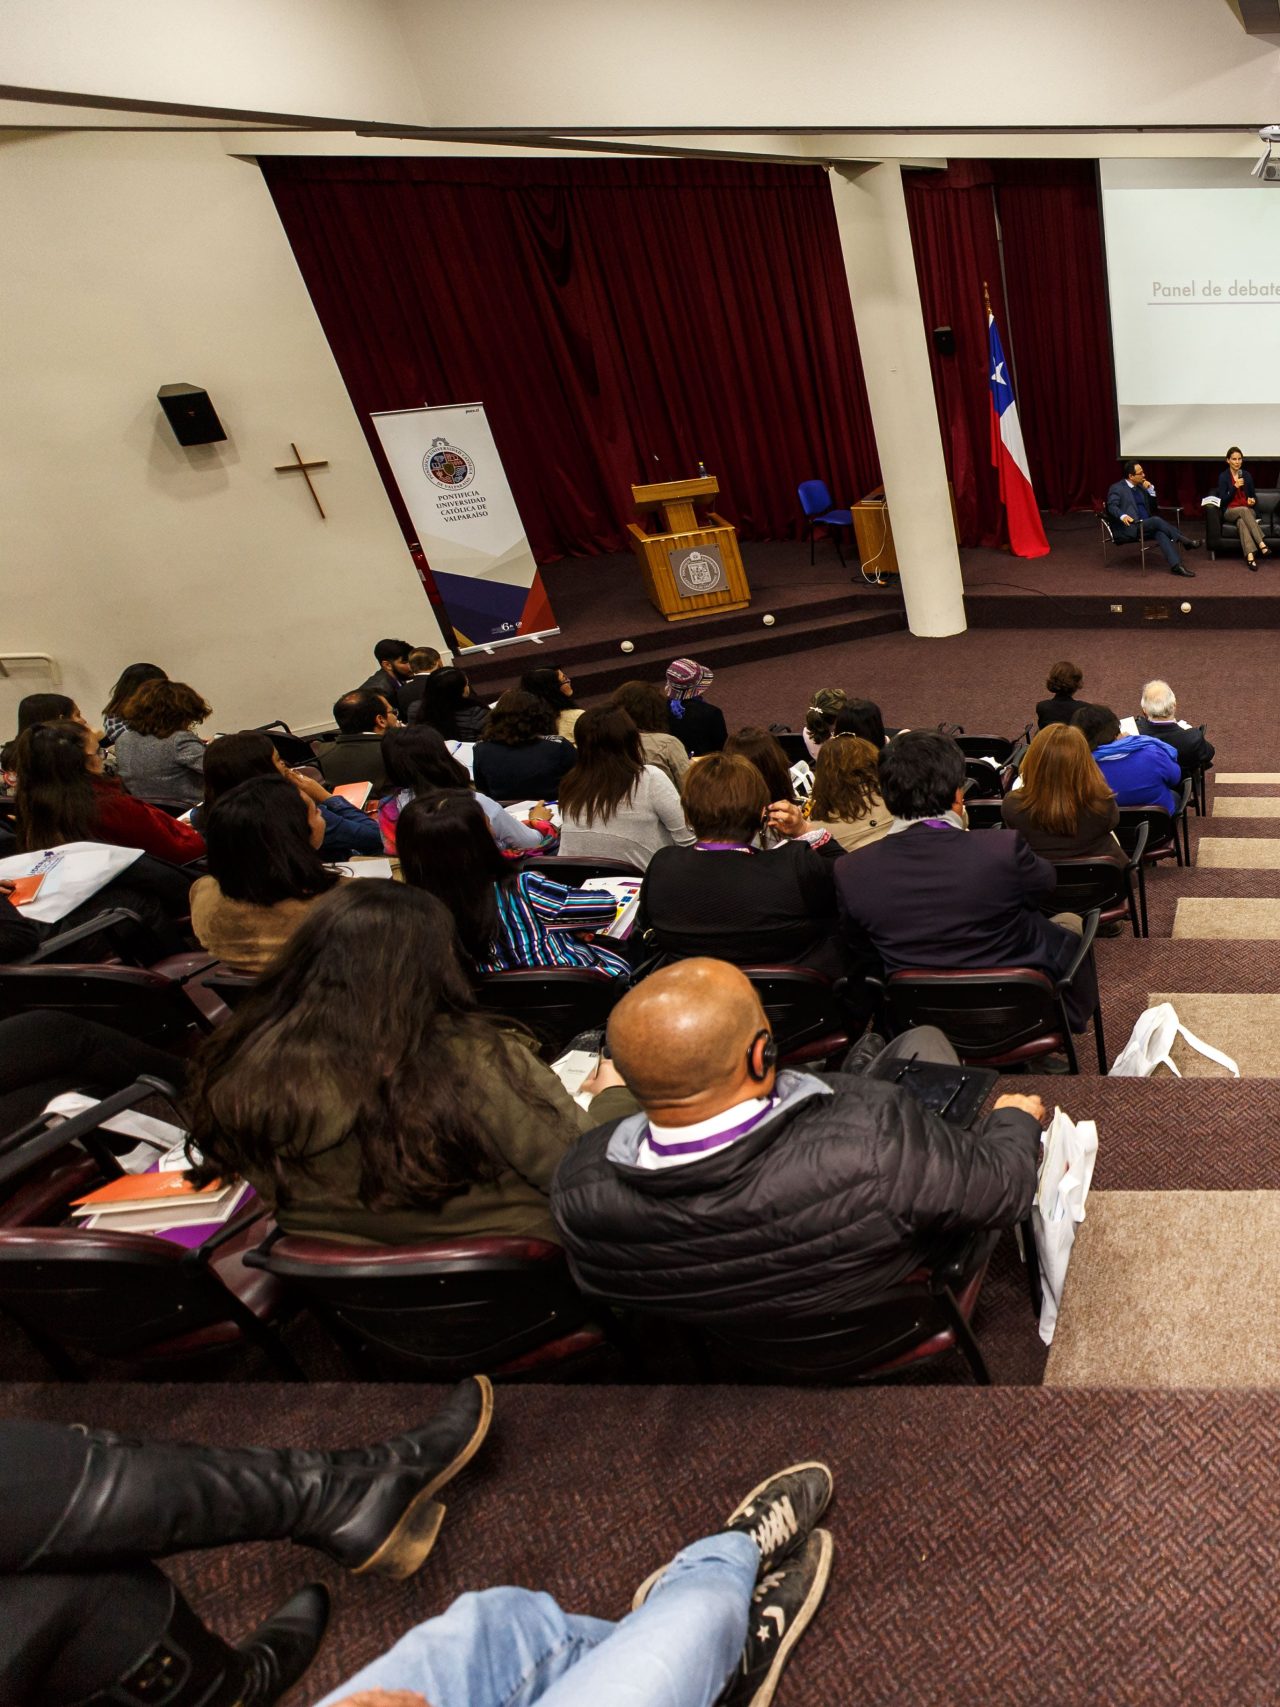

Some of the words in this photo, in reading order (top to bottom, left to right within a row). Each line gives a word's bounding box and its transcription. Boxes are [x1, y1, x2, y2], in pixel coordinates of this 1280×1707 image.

[1152, 280, 1195, 297] Panel
[1202, 280, 1222, 297] de
[438, 490, 480, 501] PONTIFICIA
[436, 496, 487, 509] UNIVERSIDAD
[440, 506, 477, 516] CATÓLICA
[444, 511, 489, 523] VALPARAÍSO
